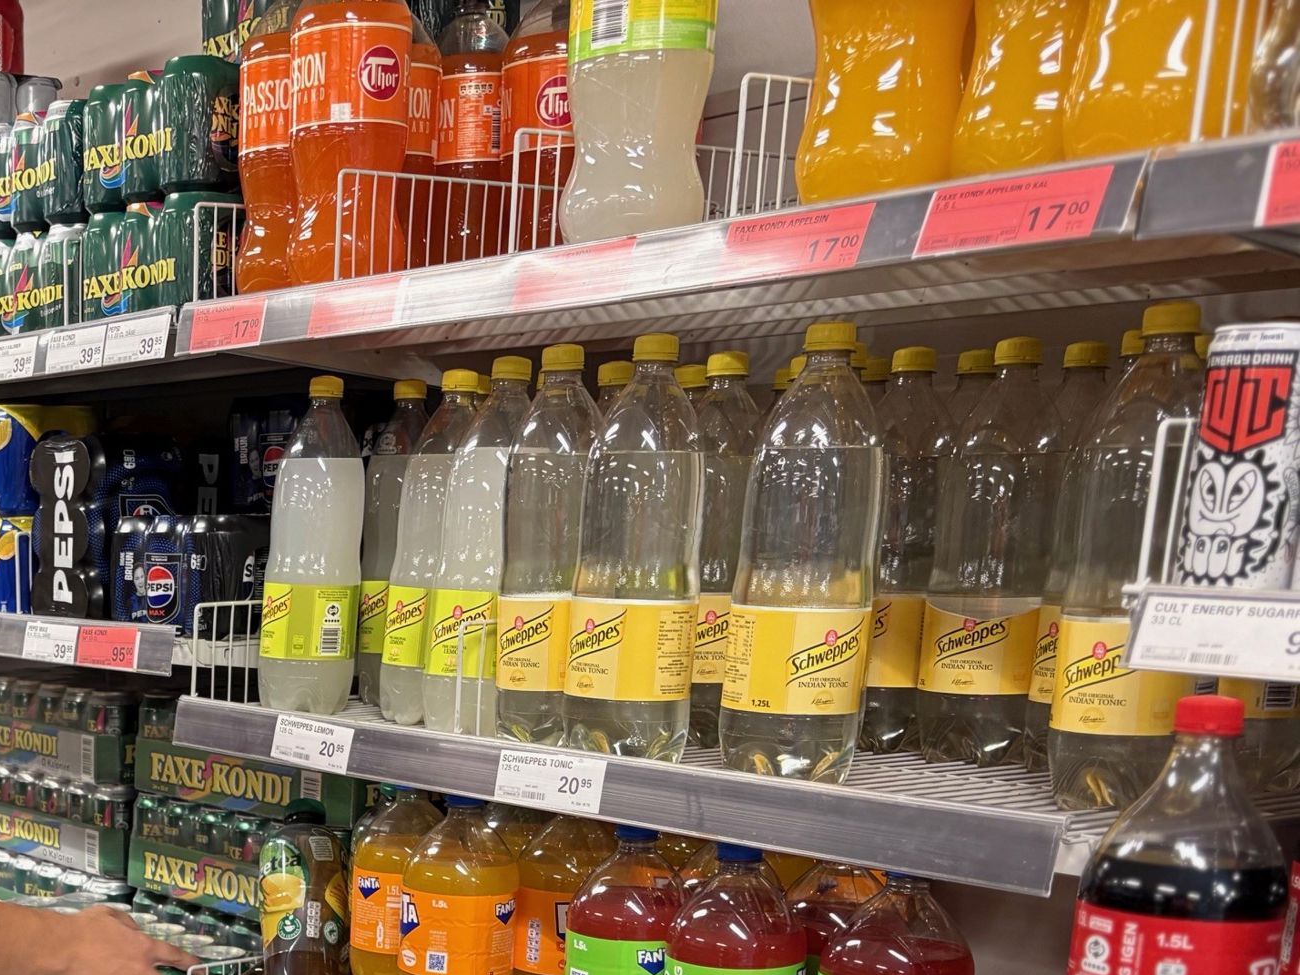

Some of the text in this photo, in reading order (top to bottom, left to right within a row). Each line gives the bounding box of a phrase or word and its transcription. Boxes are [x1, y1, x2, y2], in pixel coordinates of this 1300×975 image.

[361, 56, 399, 91] Thor
[122, 128, 173, 161] KONDI
[985, 183, 1024, 197] APPELSIN
[788, 213, 830, 230] APPELSIN
[121, 257, 177, 291] KONDI
[1210, 354, 1250, 367] ENERGY
[52, 450, 75, 605] PEPSI
[147, 581, 173, 593] PEPSI
[149, 608, 166, 617] MAX
[1154, 601, 1243, 617] CULT ENERGY
[433, 608, 488, 642] Schweppes
[1150, 614, 1183, 627] 33 CL
[500, 620, 549, 653] Schweppes
[570, 622, 621, 656] Schweppes
[936, 620, 1006, 657] Schweppes
[521, 661, 540, 669] TONIC
[790, 634, 860, 676] Schweppes
[588, 667, 609, 675] TONIC
[941, 663, 993, 671] INDIAN TONIC
[1068, 696, 1127, 707] INDIAN TONIC
[279, 717, 335, 737] SCHWEPPES LEMON
[12, 728, 58, 757] KONDI
[502, 753, 574, 770] SCHWEPPES TONIC
[150, 751, 293, 807] FAXE KONDI
[13, 817, 61, 849] KONDI
[143, 851, 198, 893] FAXE
[357, 875, 380, 889] FANTA
[1120, 921, 1138, 964] IGEN
[1155, 932, 1195, 951] 1.5L
